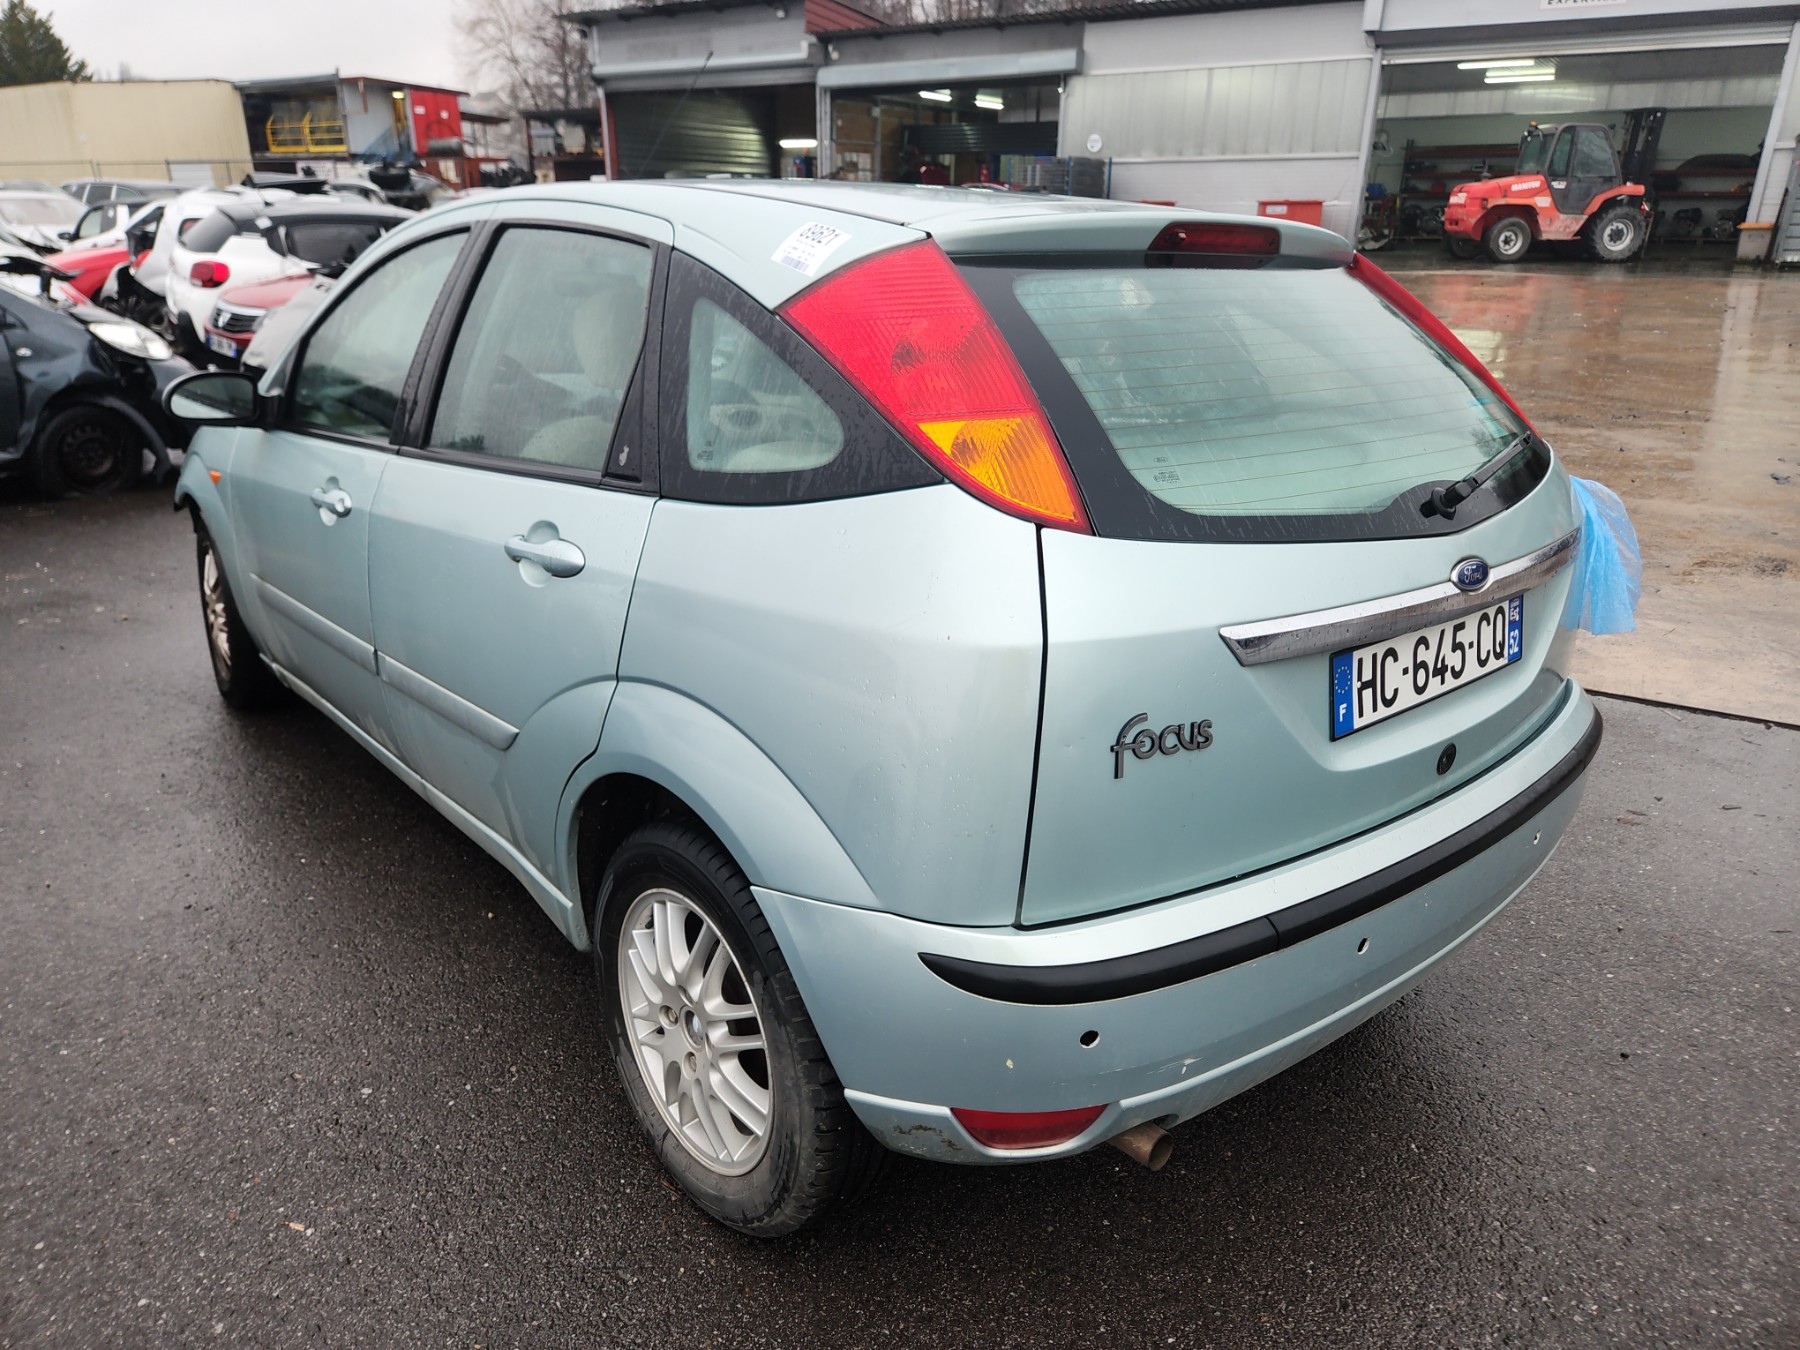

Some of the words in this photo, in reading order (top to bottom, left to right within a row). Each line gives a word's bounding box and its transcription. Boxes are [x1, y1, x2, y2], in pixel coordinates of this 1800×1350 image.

[1464, 564, 1483, 584] Ford
[1509, 628, 1519, 656] 52
[1357, 604, 1507, 719] HC-645-CQ
[1339, 702, 1348, 723] F
